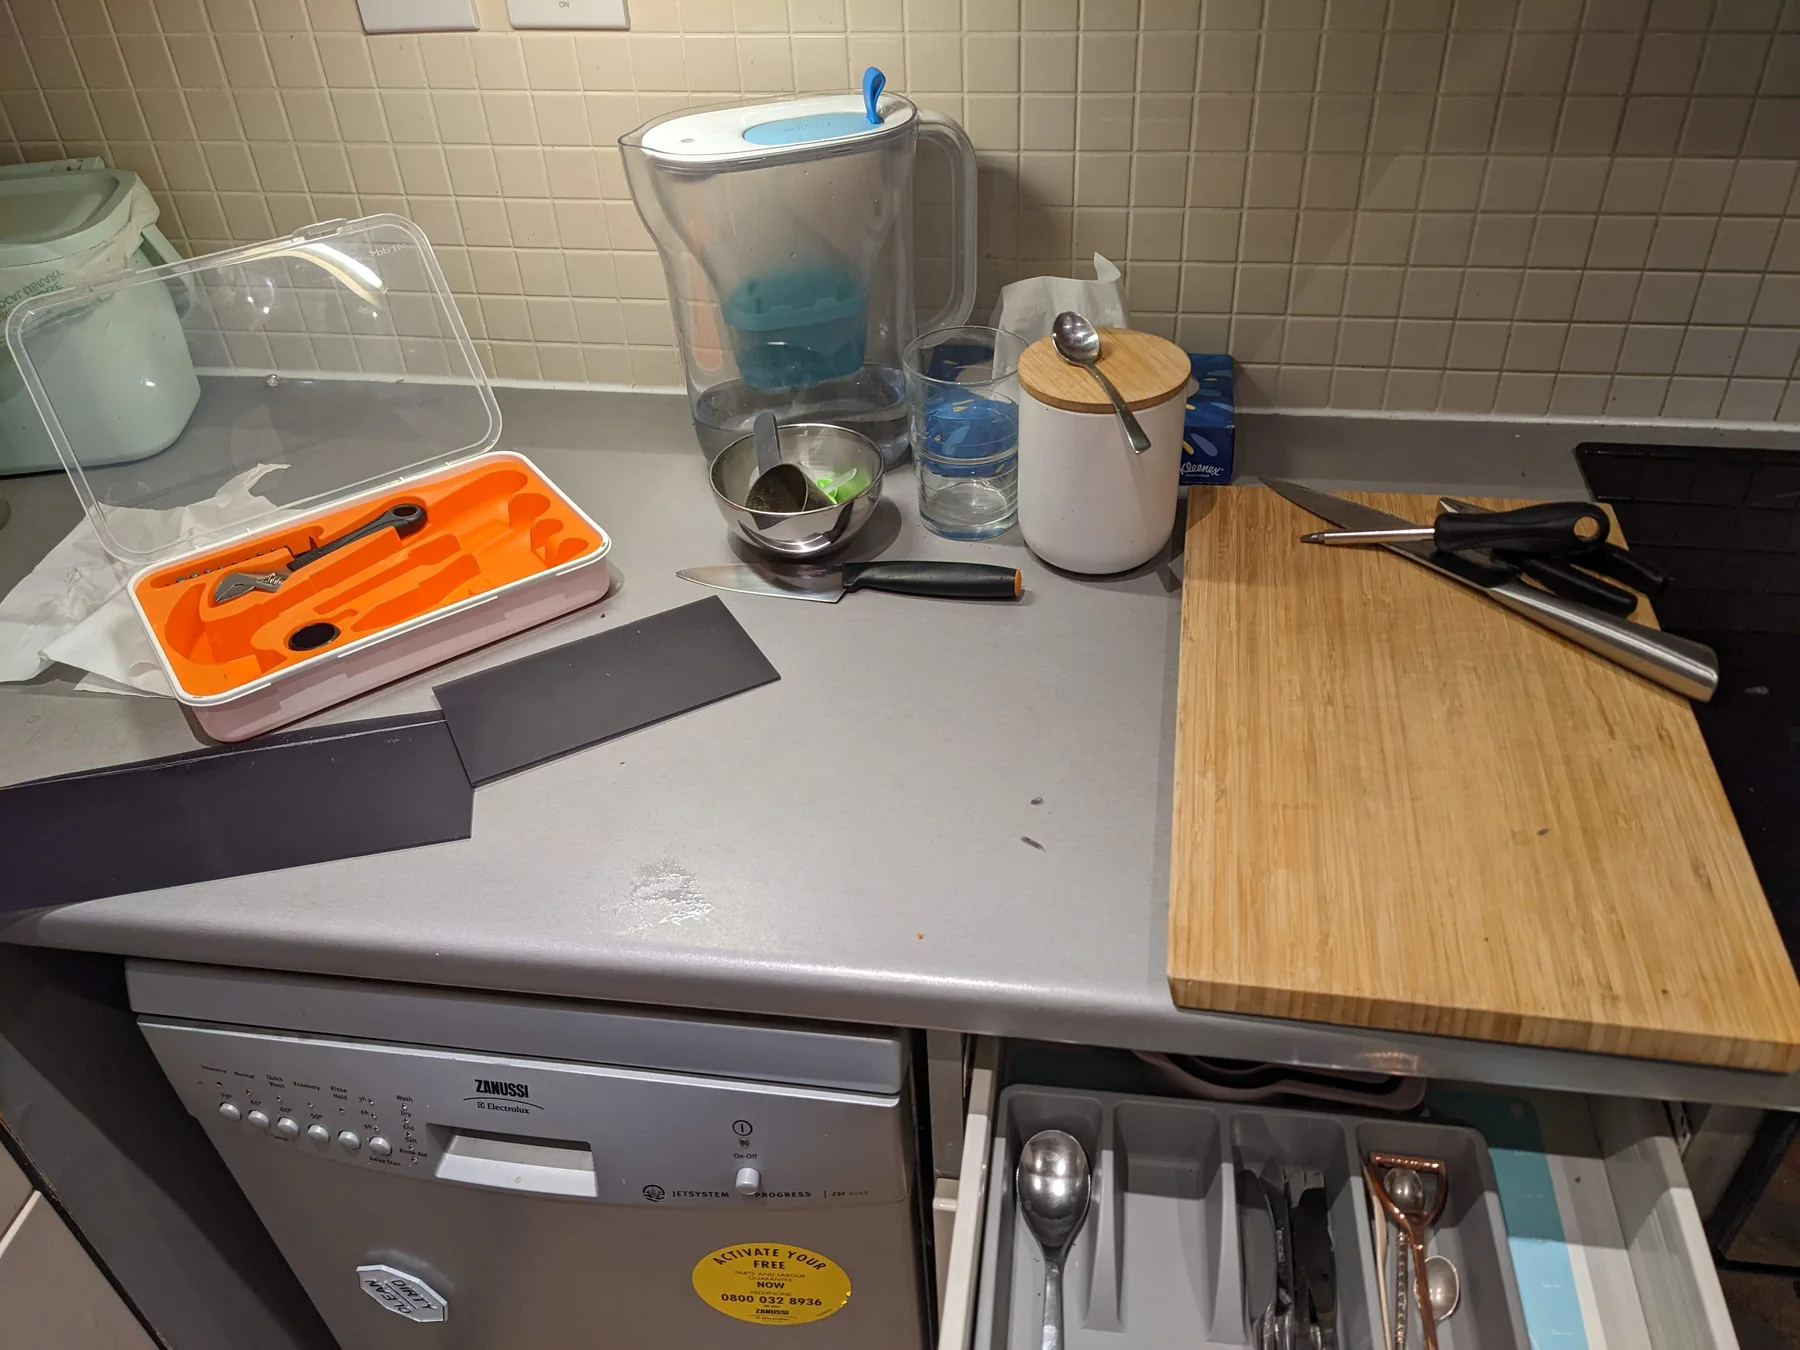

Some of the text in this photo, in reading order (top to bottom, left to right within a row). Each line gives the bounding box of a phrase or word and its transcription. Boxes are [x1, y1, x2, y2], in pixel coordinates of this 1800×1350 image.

[234, 1071, 255, 1079] Normal
[266, 1074, 284, 1082] Quick
[268, 1081, 285, 1089] Wash
[293, 1081, 320, 1091] Economy
[330, 1085, 348, 1093] Rinse
[474, 1079, 529, 1098] ZANUSSI
[332, 1093, 348, 1101] Hold
[395, 1094, 413, 1102] Wash
[487, 1102, 530, 1114] Electrolux
[401, 1110, 412, 1118] Dry
[405, 1136, 418, 1144] Salt
[672, 1190, 812, 1199] JETSYSTEM PROGRESS
[713, 1248, 827, 1271] ACTIVATE YOUR
[753, 1260, 786, 1270] FREE
[757, 1281, 785, 1289] NOW
[364, 1279, 412, 1314] CLEAN
[391, 1279, 436, 1311] DIRTY
[721, 1293, 754, 1303] 0800
[759, 1296, 784, 1305] 032
[788, 1297, 823, 1307] 8936
[755, 1308, 790, 1316] ZANUSSI
